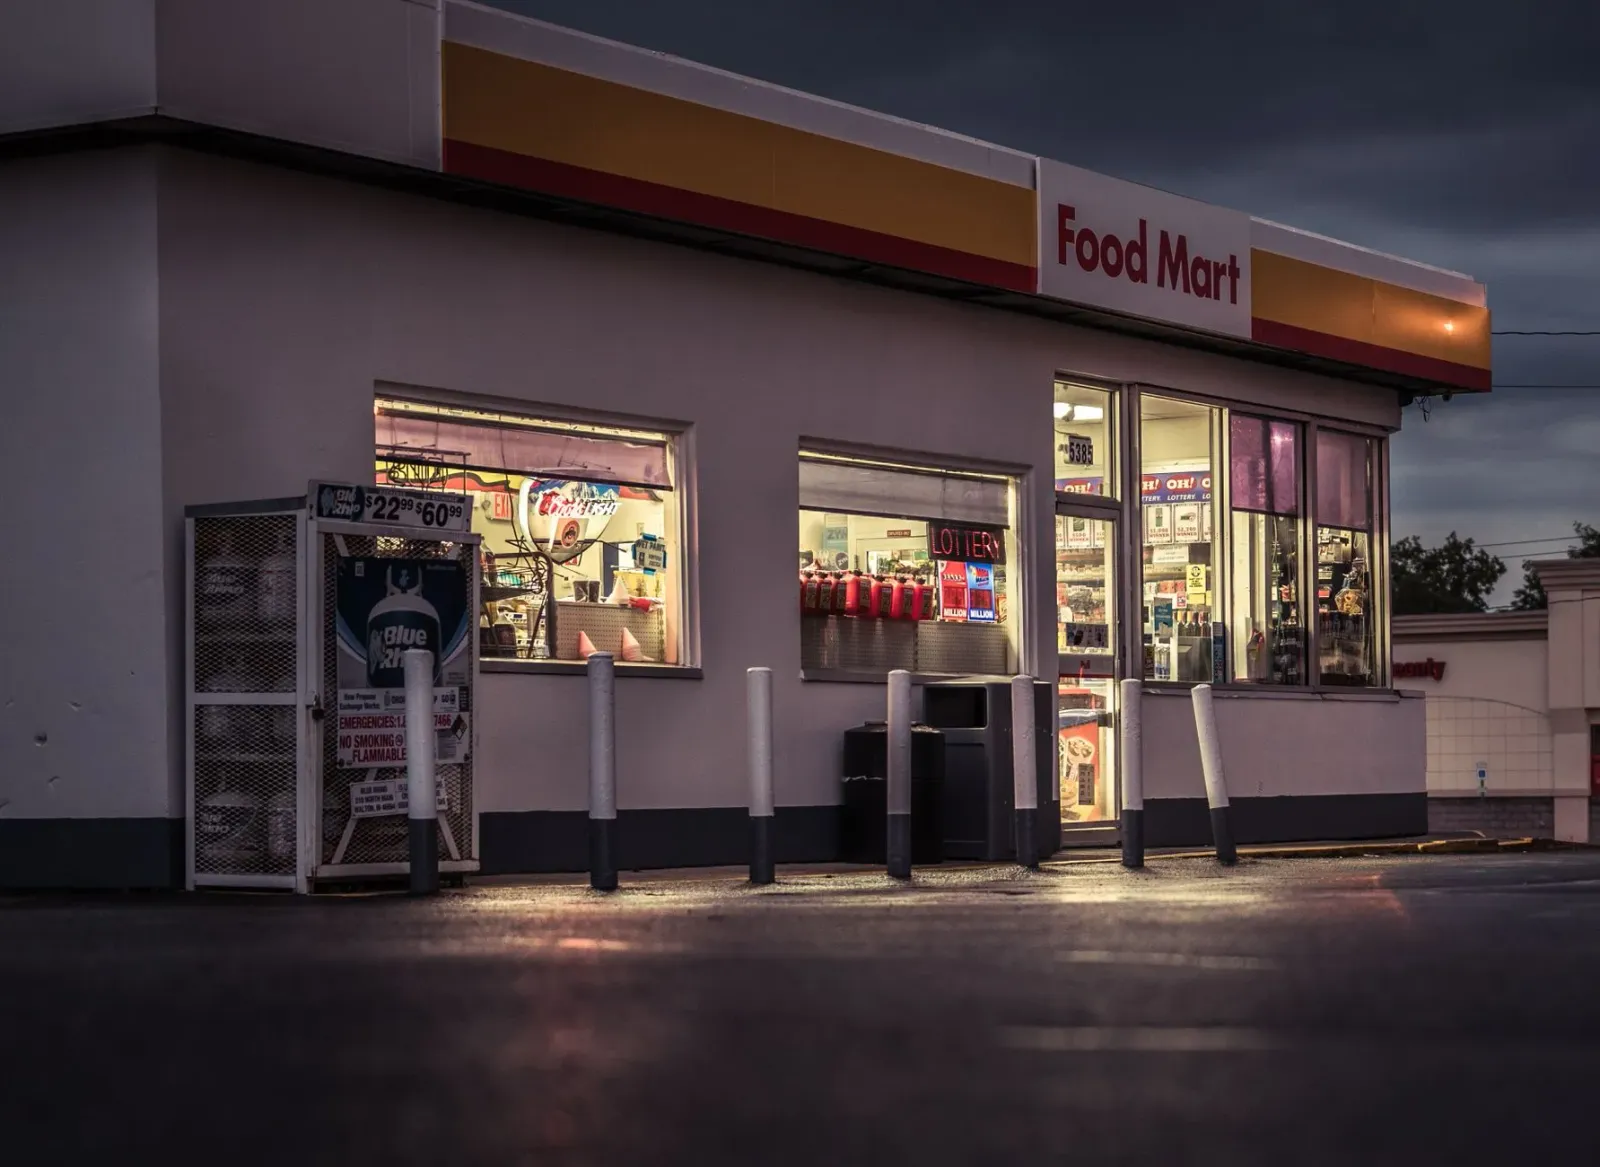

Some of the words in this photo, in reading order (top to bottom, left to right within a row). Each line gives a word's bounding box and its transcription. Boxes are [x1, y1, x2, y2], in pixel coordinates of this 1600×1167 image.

[1057, 203, 1148, 284] Food
[1157, 229, 1240, 304] Mart
[1069, 441, 1094, 465] 5385
[1142, 478, 1160, 491] H!
[1166, 477, 1195, 490] OH!
[931, 527, 1000, 560] LOTTERY
[943, 608, 967, 618] MILLION
[384, 624, 428, 646] Blue
[340, 735, 352, 749] NO
[354, 734, 395, 748] SMOKING
[353, 748, 407, 763] FLAMMABLE
